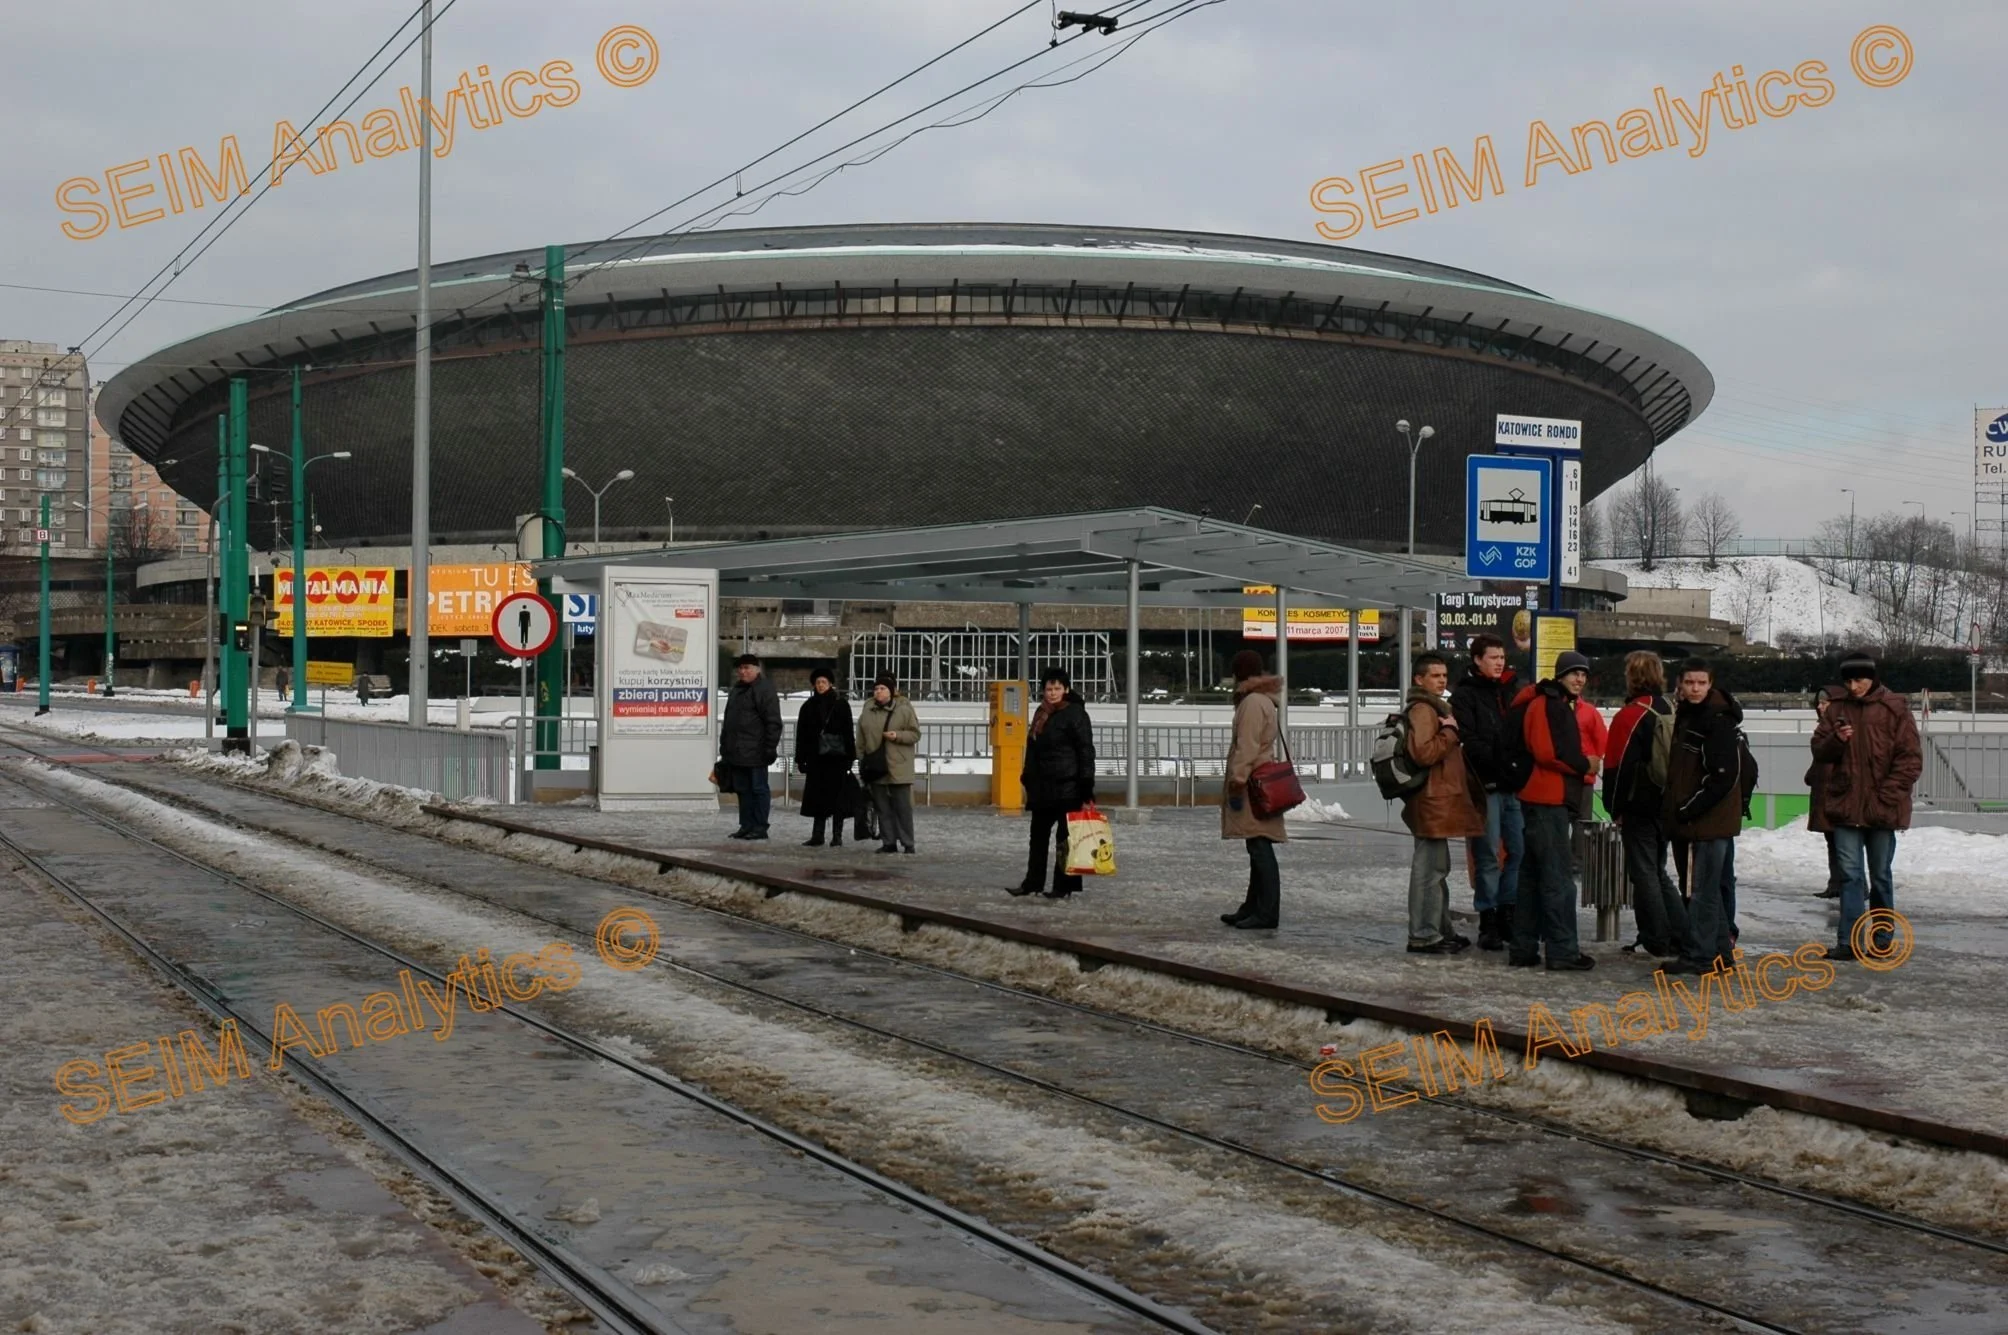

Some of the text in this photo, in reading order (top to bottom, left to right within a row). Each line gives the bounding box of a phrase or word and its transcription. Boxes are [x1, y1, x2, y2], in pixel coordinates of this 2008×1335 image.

[1498, 421, 1578, 439] KATOWICE RONDO
[1982, 463, 2007, 473] Tel.
[1573, 469, 1578, 479] 6
[1569, 481, 1578, 491] 11
[1569, 505, 1578, 515] 13
[1569, 517, 1577, 528] 14
[1569, 530, 1578, 540] 16
[1516, 546, 1536, 557] KZK
[1567, 542, 1578, 552] 23
[1514, 558, 1537, 568] GOP
[1567, 566, 1577, 576] 41
[470, 567, 499, 587] TU
[277, 578, 390, 594] MTALMANIA
[1440, 592, 1522, 609] Targi Turystyczne
[1257, 609, 1299, 618] KONES
[577, 624, 594, 635] luty
[1295, 627, 1322, 635] marca
[1325, 626, 1344, 634] 2007
[619, 676, 703, 687] kupuj korzystniej
[618, 688, 703, 702] zbieraj punkty
[658, 705, 669, 713] na
[670, 705, 704, 714] nagrody!
